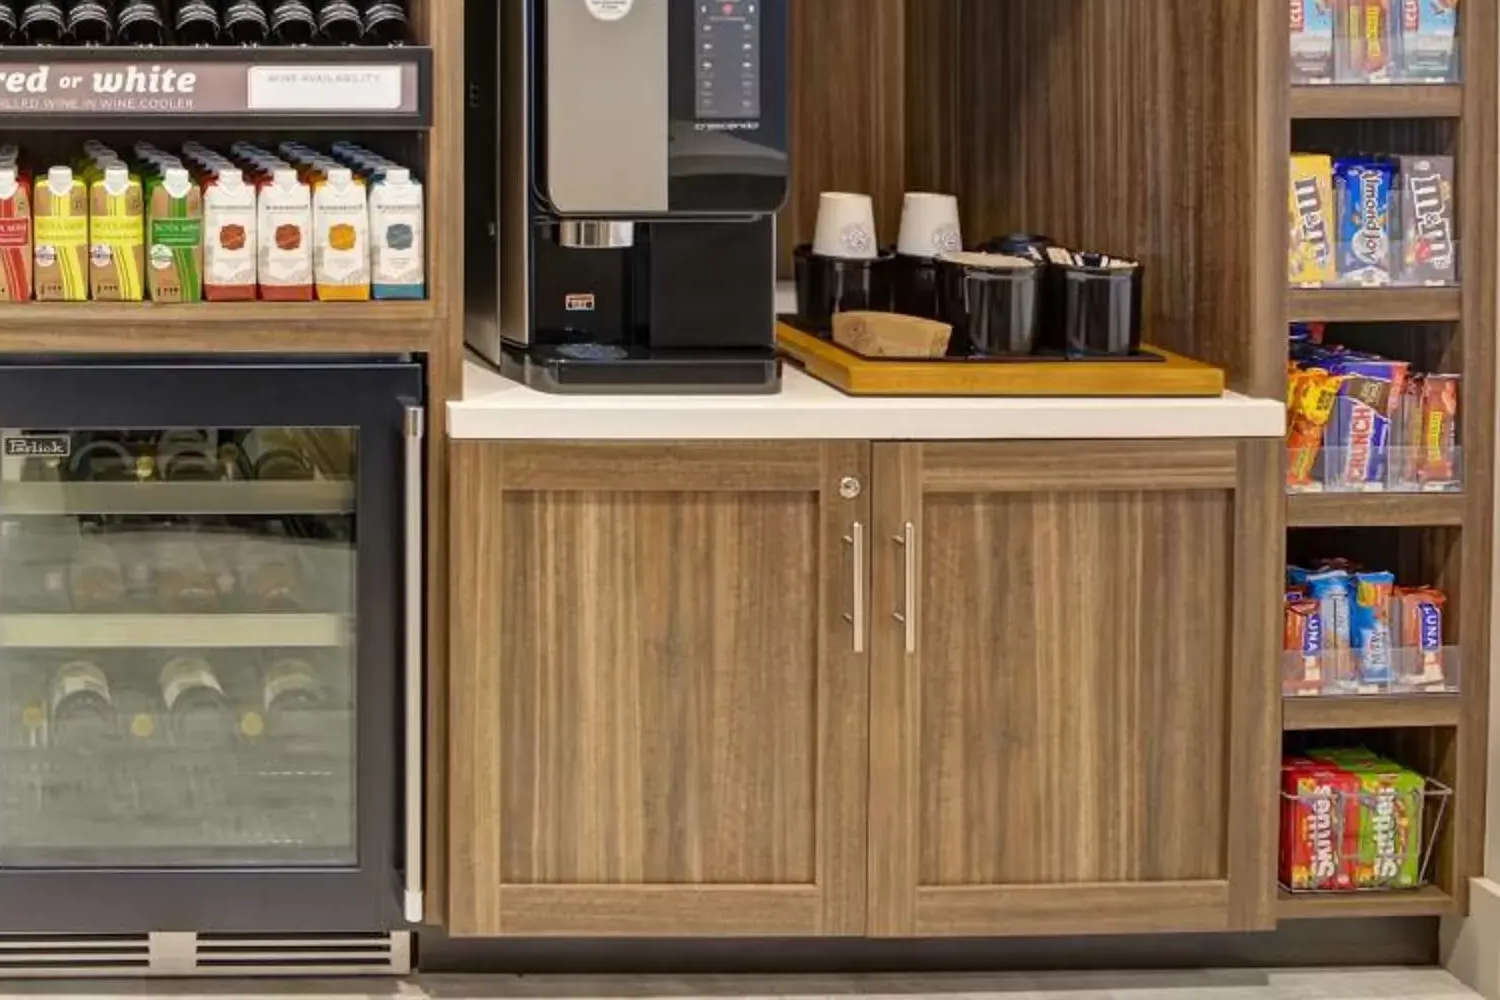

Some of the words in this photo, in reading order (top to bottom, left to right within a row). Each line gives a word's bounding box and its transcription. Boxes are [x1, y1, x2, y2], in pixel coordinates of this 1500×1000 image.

[59, 75, 83, 89] or
[92, 64, 197, 94] white
[43, 98, 76, 111] WINE
[100, 98, 139, 111] WINE
[140, 98, 195, 111] COOLER
